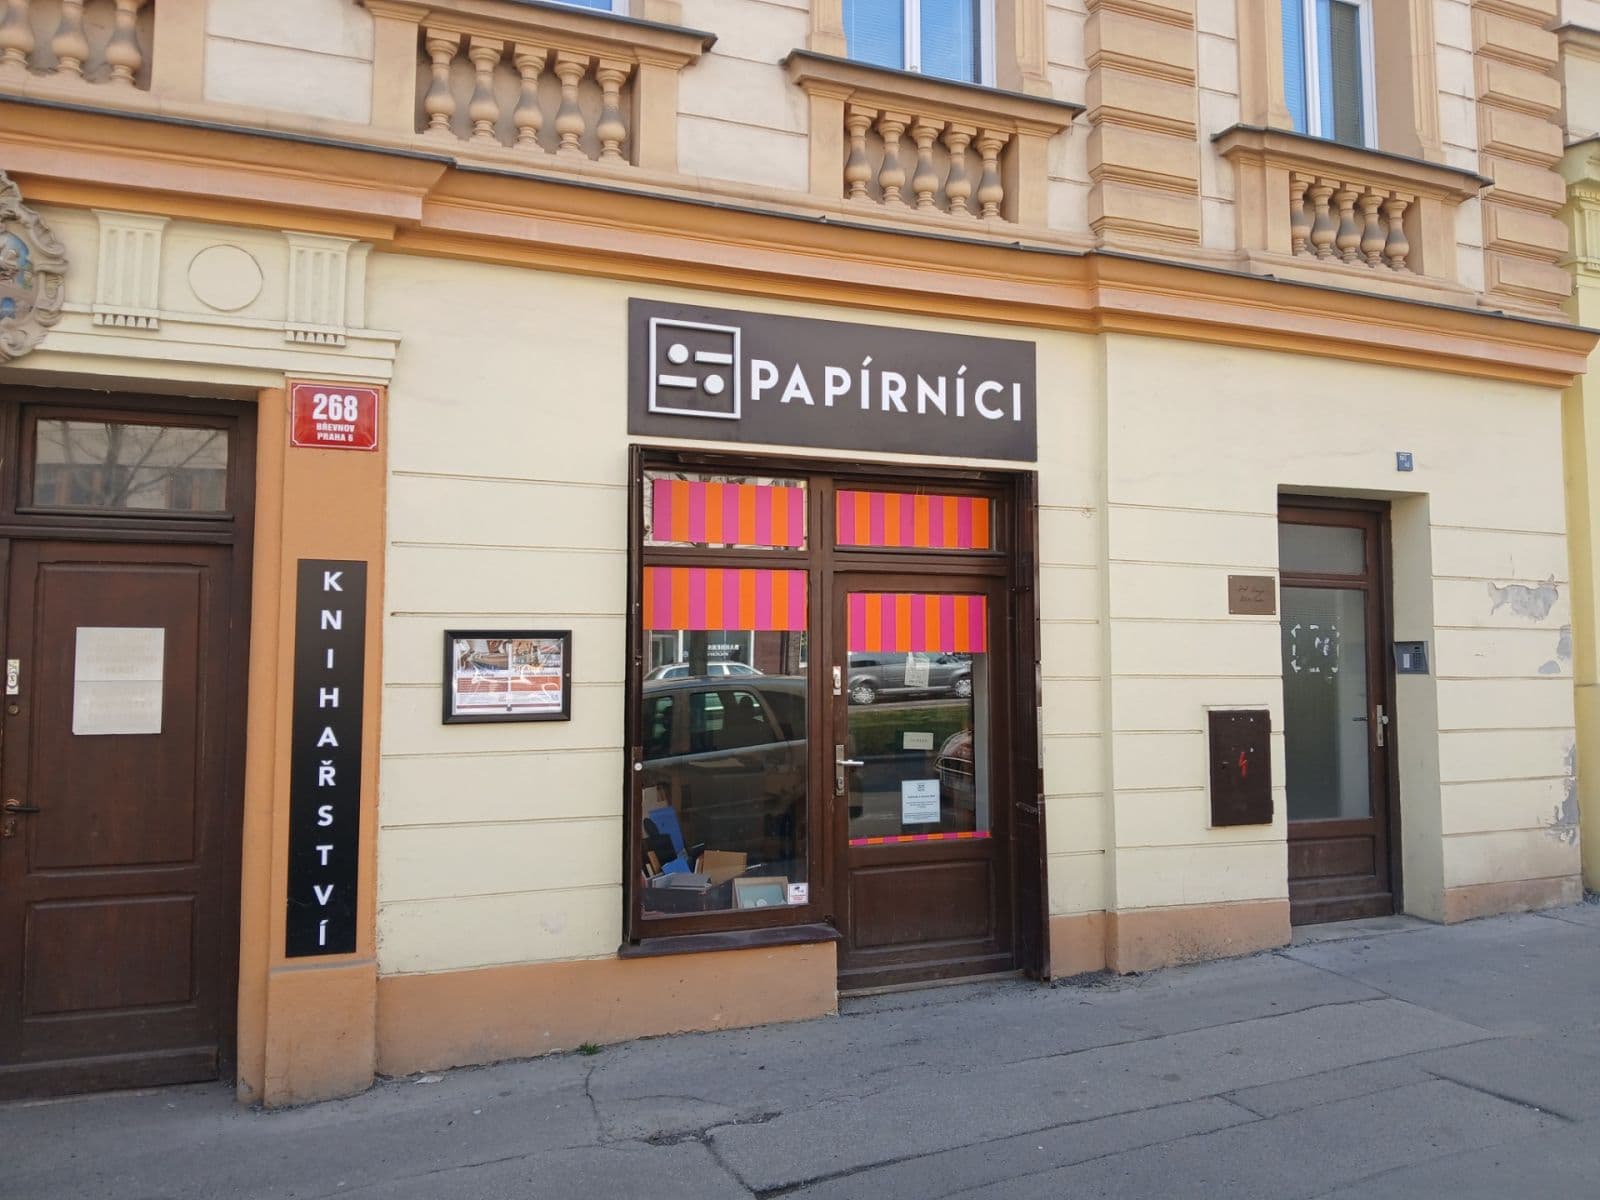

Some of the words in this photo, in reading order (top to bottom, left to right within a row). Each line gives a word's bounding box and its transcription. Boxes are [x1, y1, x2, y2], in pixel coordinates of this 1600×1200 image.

[312, 393, 359, 422] 268
[750, 355, 1023, 422] PAPÍRNÍCI
[316, 432, 346, 442] PRAHA
[313, 571, 343, 947] KNIHAŘSTVÍ
